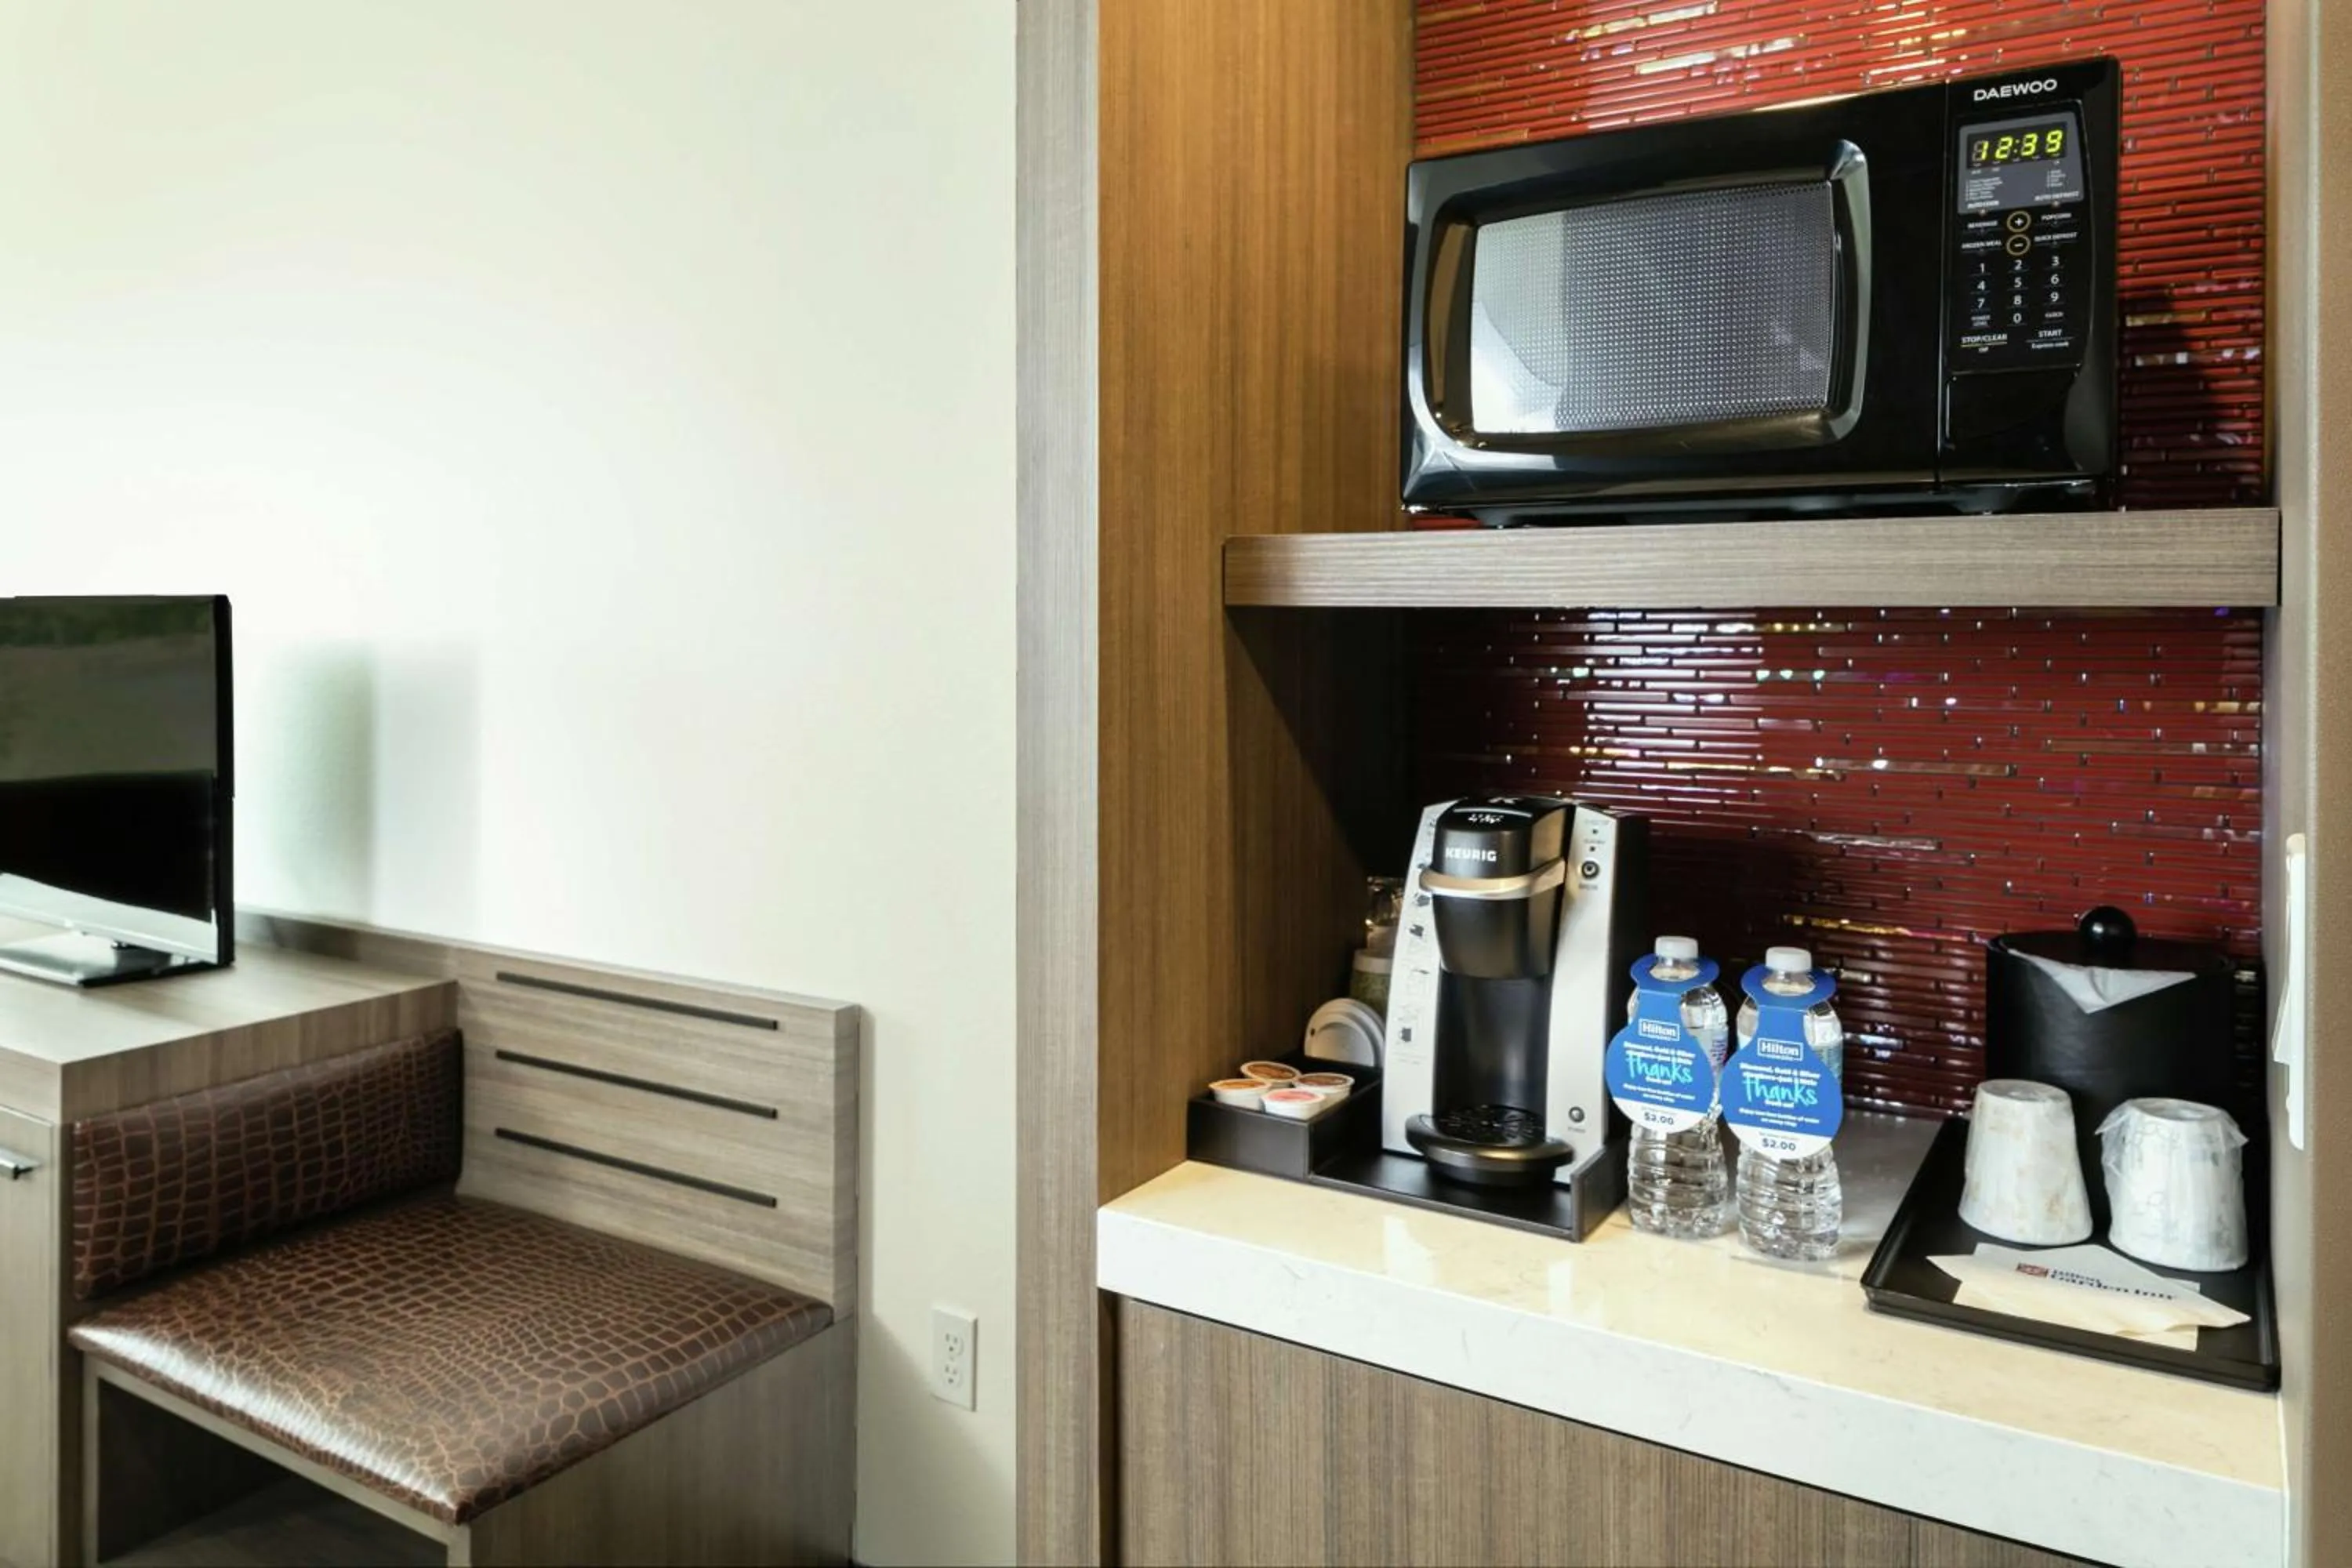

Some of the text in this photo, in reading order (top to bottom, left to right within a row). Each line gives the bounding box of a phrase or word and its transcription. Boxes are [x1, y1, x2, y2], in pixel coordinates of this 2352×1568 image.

[1973, 79, 2057, 101] DAEWOO
[1980, 129, 2063, 161] 12:39
[2015, 260, 2023, 270] 2
[2052, 256, 2060, 267] 3
[1980, 263, 1986, 273] 1
[2014, 278, 2022, 288] 5
[2050, 274, 2059, 285] 6
[1976, 281, 1985, 291] 4
[2014, 295, 2022, 305] 8
[2050, 292, 2059, 302] 9
[1977, 298, 1985, 308] 7
[2013, 314, 2021, 323] 0
[1961, 333, 2008, 344] STOP/CLEAR
[2038, 328, 2062, 338] START
[1444, 847, 1497, 862] KEURIG
[1642, 1022, 1676, 1037] Hilton
[1761, 1041, 1798, 1056] Hilton
[1625, 1052, 1693, 1085] Thanks
[1742, 1074, 1818, 1106] Thanks
[1643, 1112, 1675, 1126] $2.00
[1762, 1138, 1797, 1151] $2.00
